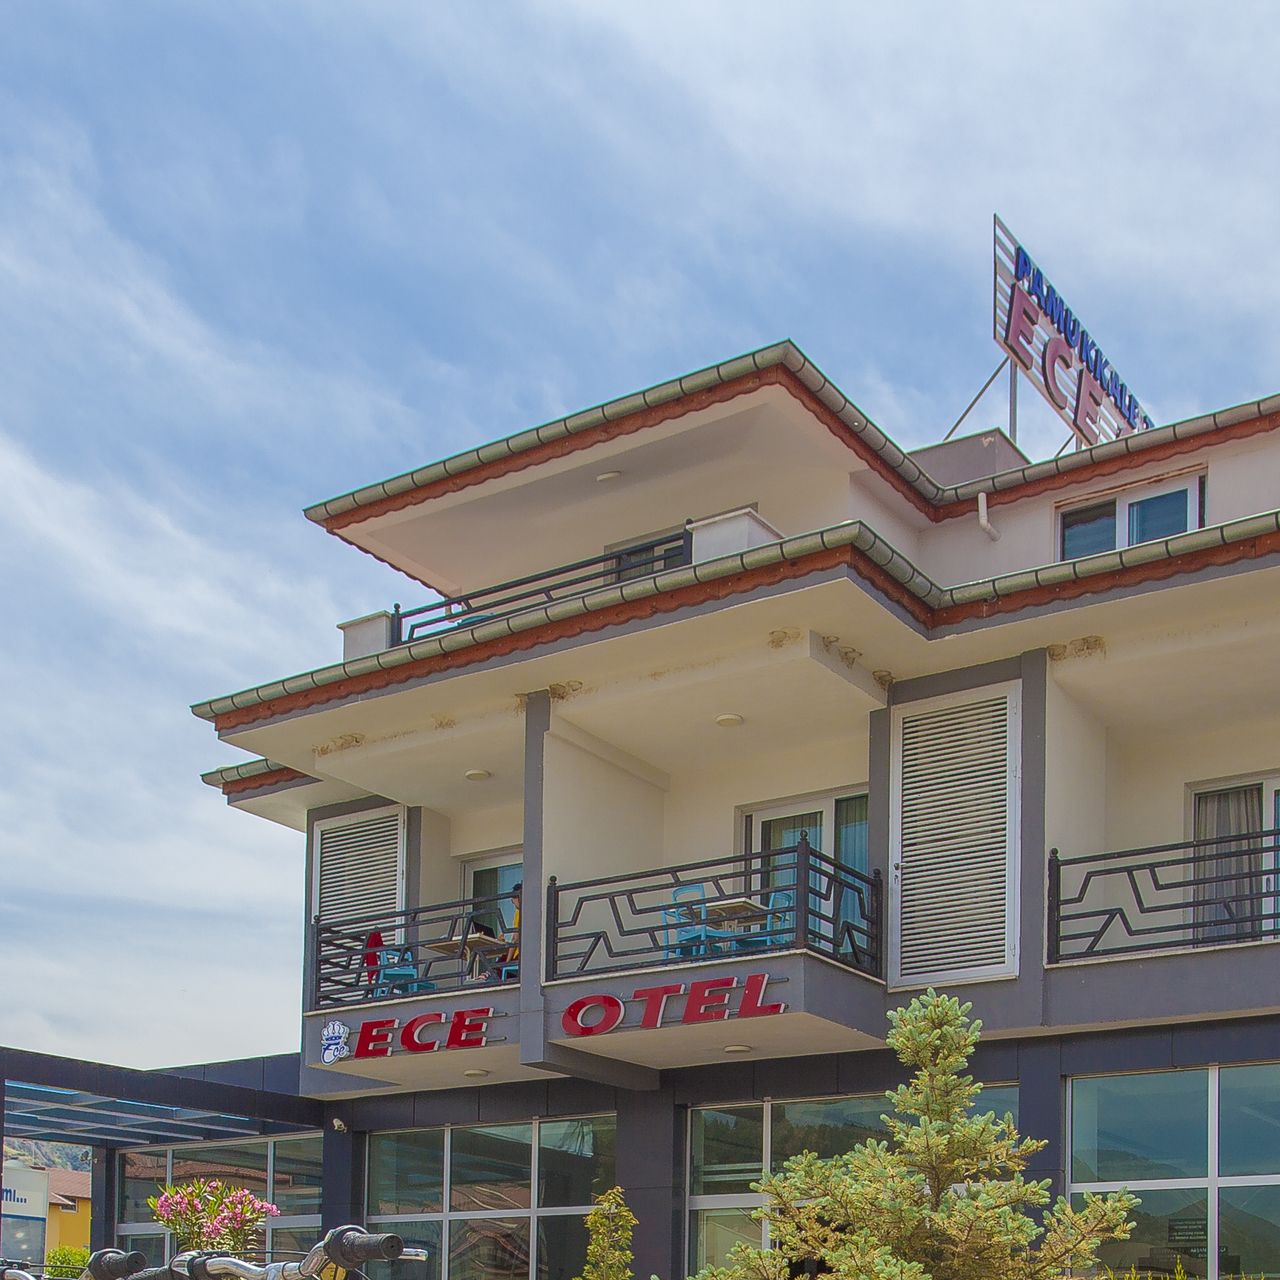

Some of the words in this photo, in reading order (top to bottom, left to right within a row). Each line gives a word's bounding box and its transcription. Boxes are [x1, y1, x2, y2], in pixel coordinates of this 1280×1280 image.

[1004, 281, 1102, 447] ECE
[1014, 246, 1140, 430] PAMUKKALE
[354, 1007, 495, 1058] ECE
[560, 973, 786, 1036] OTEL
